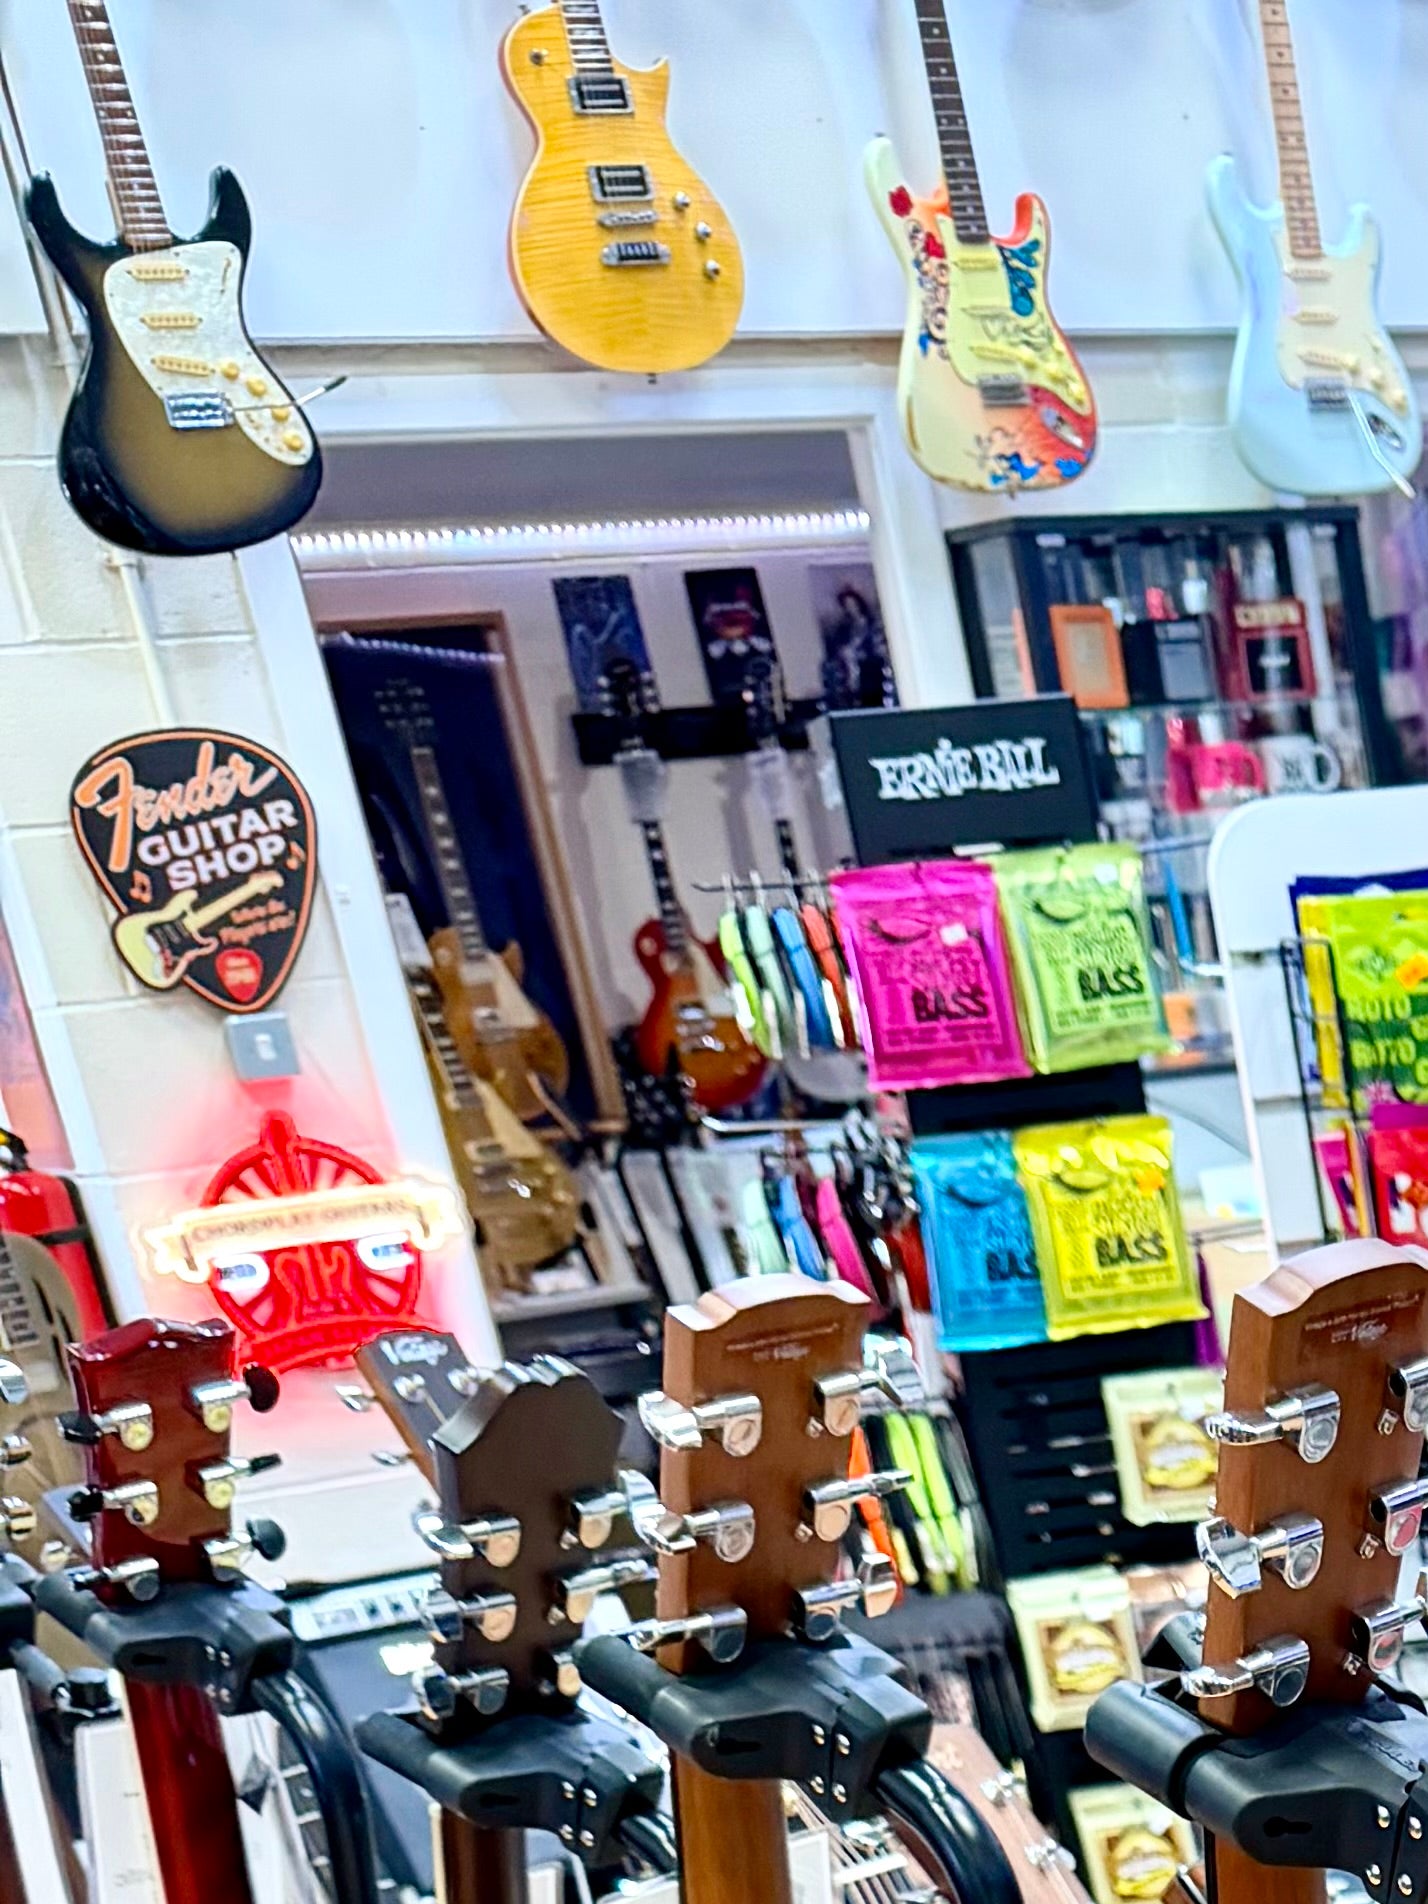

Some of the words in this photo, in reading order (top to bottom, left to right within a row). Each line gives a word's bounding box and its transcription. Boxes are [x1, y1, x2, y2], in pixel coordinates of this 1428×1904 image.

[869, 738, 977, 800] ERNIE
[977, 738, 1061, 791] BALL
[75, 741, 279, 872] Fender
[137, 799, 298, 866] GUITAR
[166, 834, 286, 891] SHOP
[911, 981, 989, 1023] BASS
[1078, 965, 1146, 1000] BASS
[1095, 1231, 1169, 1269] BASS
